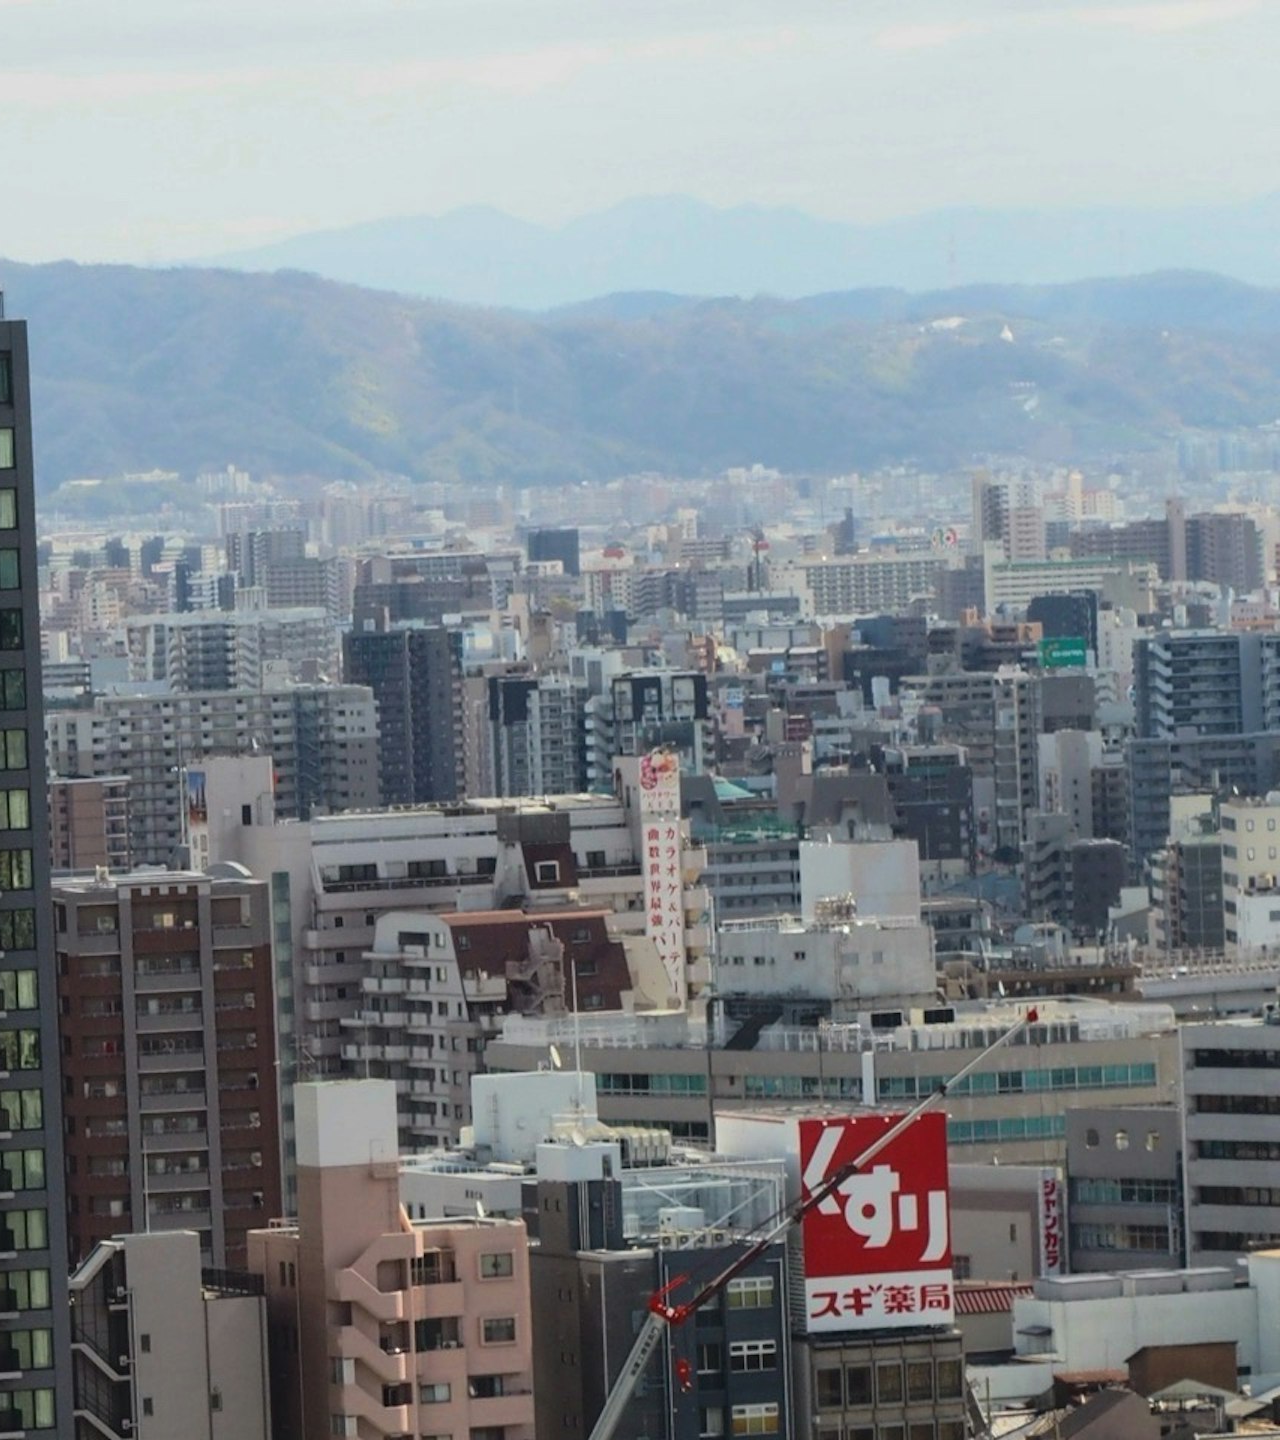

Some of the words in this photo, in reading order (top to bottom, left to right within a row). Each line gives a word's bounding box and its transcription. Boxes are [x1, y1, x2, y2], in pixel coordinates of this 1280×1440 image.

[802, 1125, 949, 1263] くすり
[1043, 1178, 1058, 1268] ジャンカラ
[810, 1283, 951, 1319] スギ薬局
